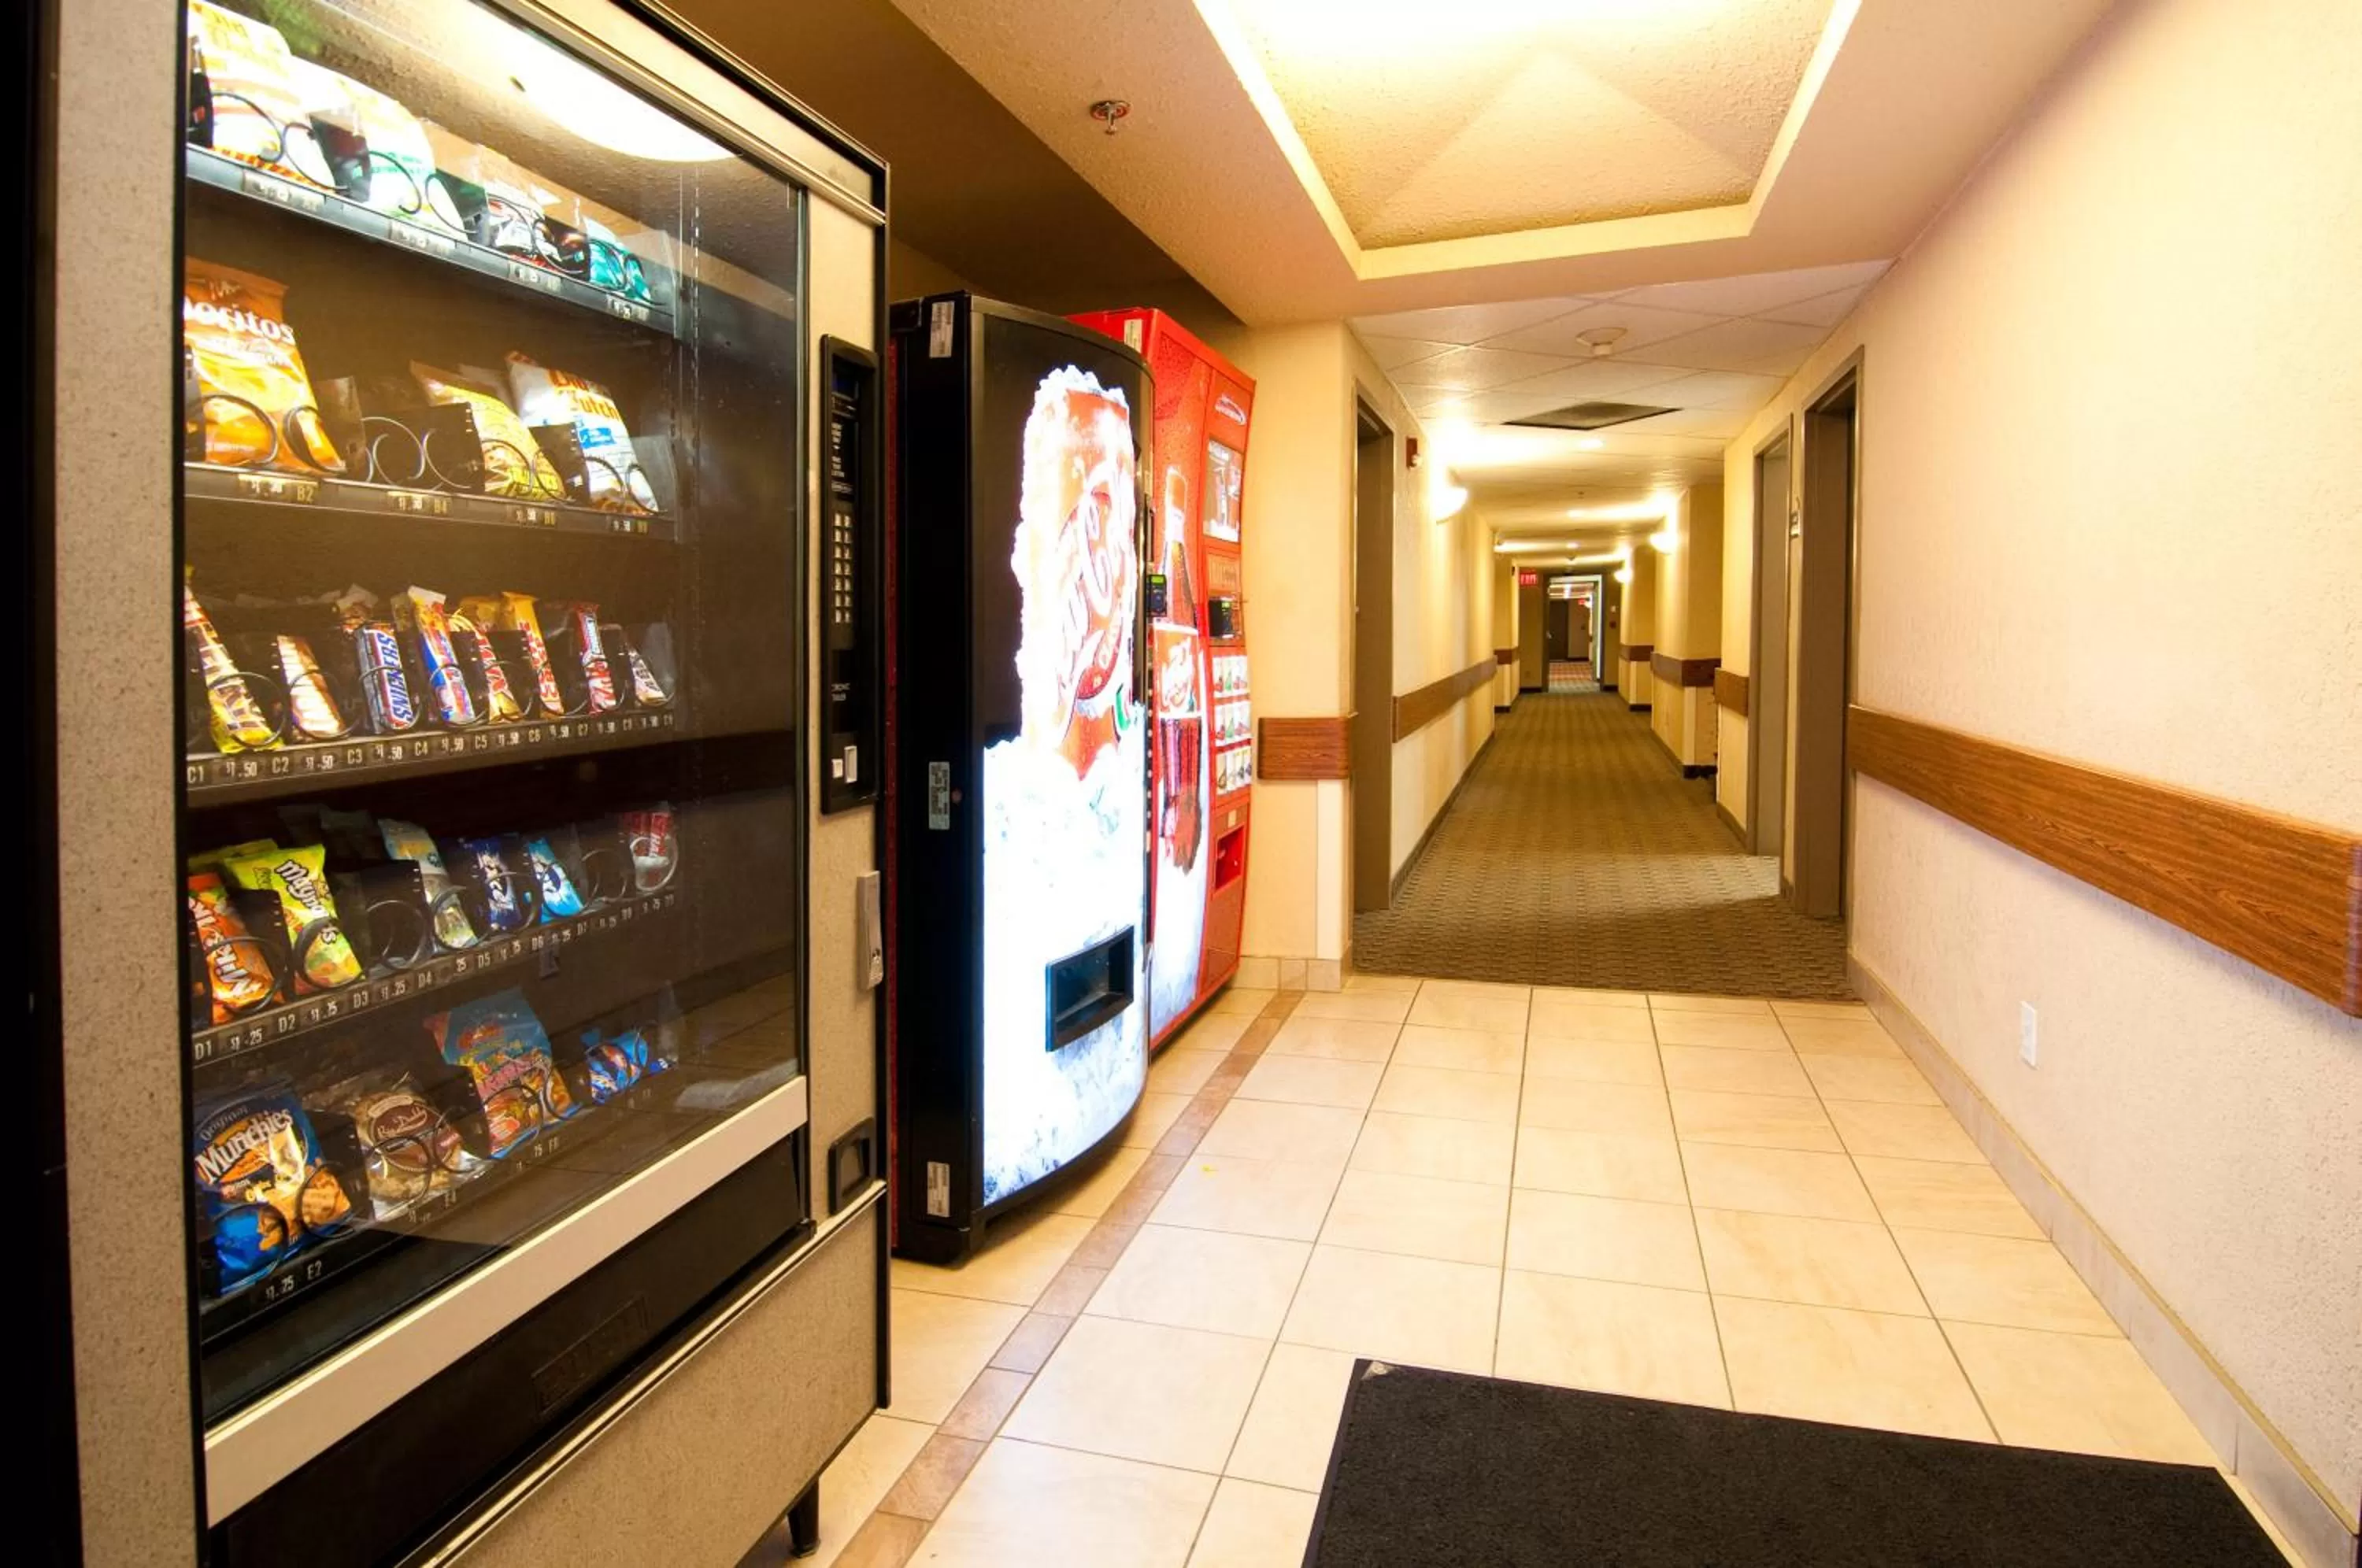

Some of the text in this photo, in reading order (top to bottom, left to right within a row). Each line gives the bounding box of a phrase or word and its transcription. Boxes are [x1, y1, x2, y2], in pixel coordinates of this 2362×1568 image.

[296, 485, 314, 504] B2
[376, 632, 413, 722] SNICKERS
[187, 766, 205, 784] C1
[272, 756, 290, 774] C2
[347, 748, 363, 765] C3
[414, 741, 428, 756] C4
[475, 734, 487, 749] C5
[528, 728, 541, 743] C6
[275, 858, 340, 944] Maynas
[195, 1041, 212, 1060] D1
[279, 1014, 295, 1034] D2
[354, 990, 368, 1008] D3
[418, 971, 431, 988] D4
[478, 951, 490, 969] D5
[194, 1108, 294, 1185] Munchies
